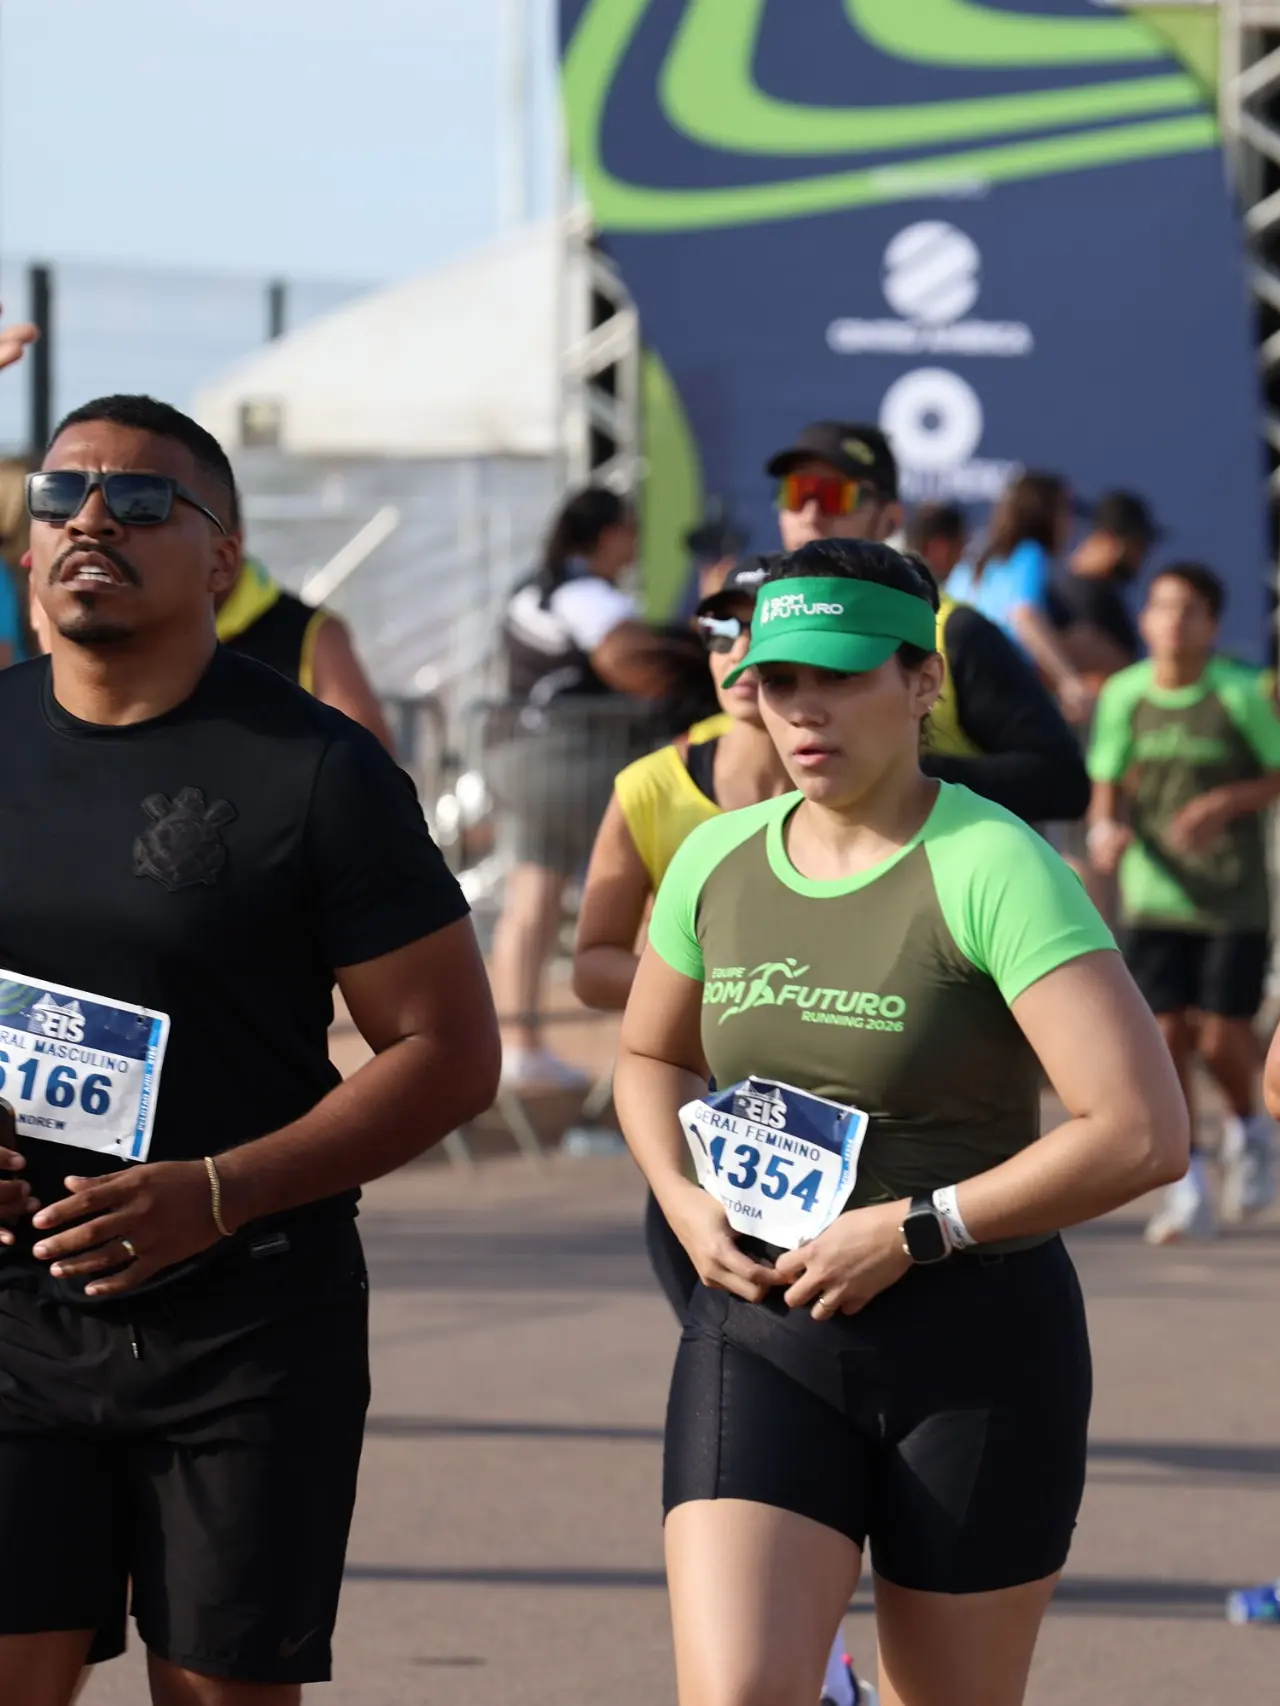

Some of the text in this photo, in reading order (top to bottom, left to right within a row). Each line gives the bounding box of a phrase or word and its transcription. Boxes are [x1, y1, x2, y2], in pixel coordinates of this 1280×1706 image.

[770, 602, 844, 621] FUTURO
[776, 985, 906, 1018] FUTURO
[802, 1010, 905, 1032] RUNNING 2026
[33, 1040, 129, 1074] MASCULINO
[16, 1113, 66, 1130] NDREW
[695, 1107, 820, 1162] GERAL FEMININO
